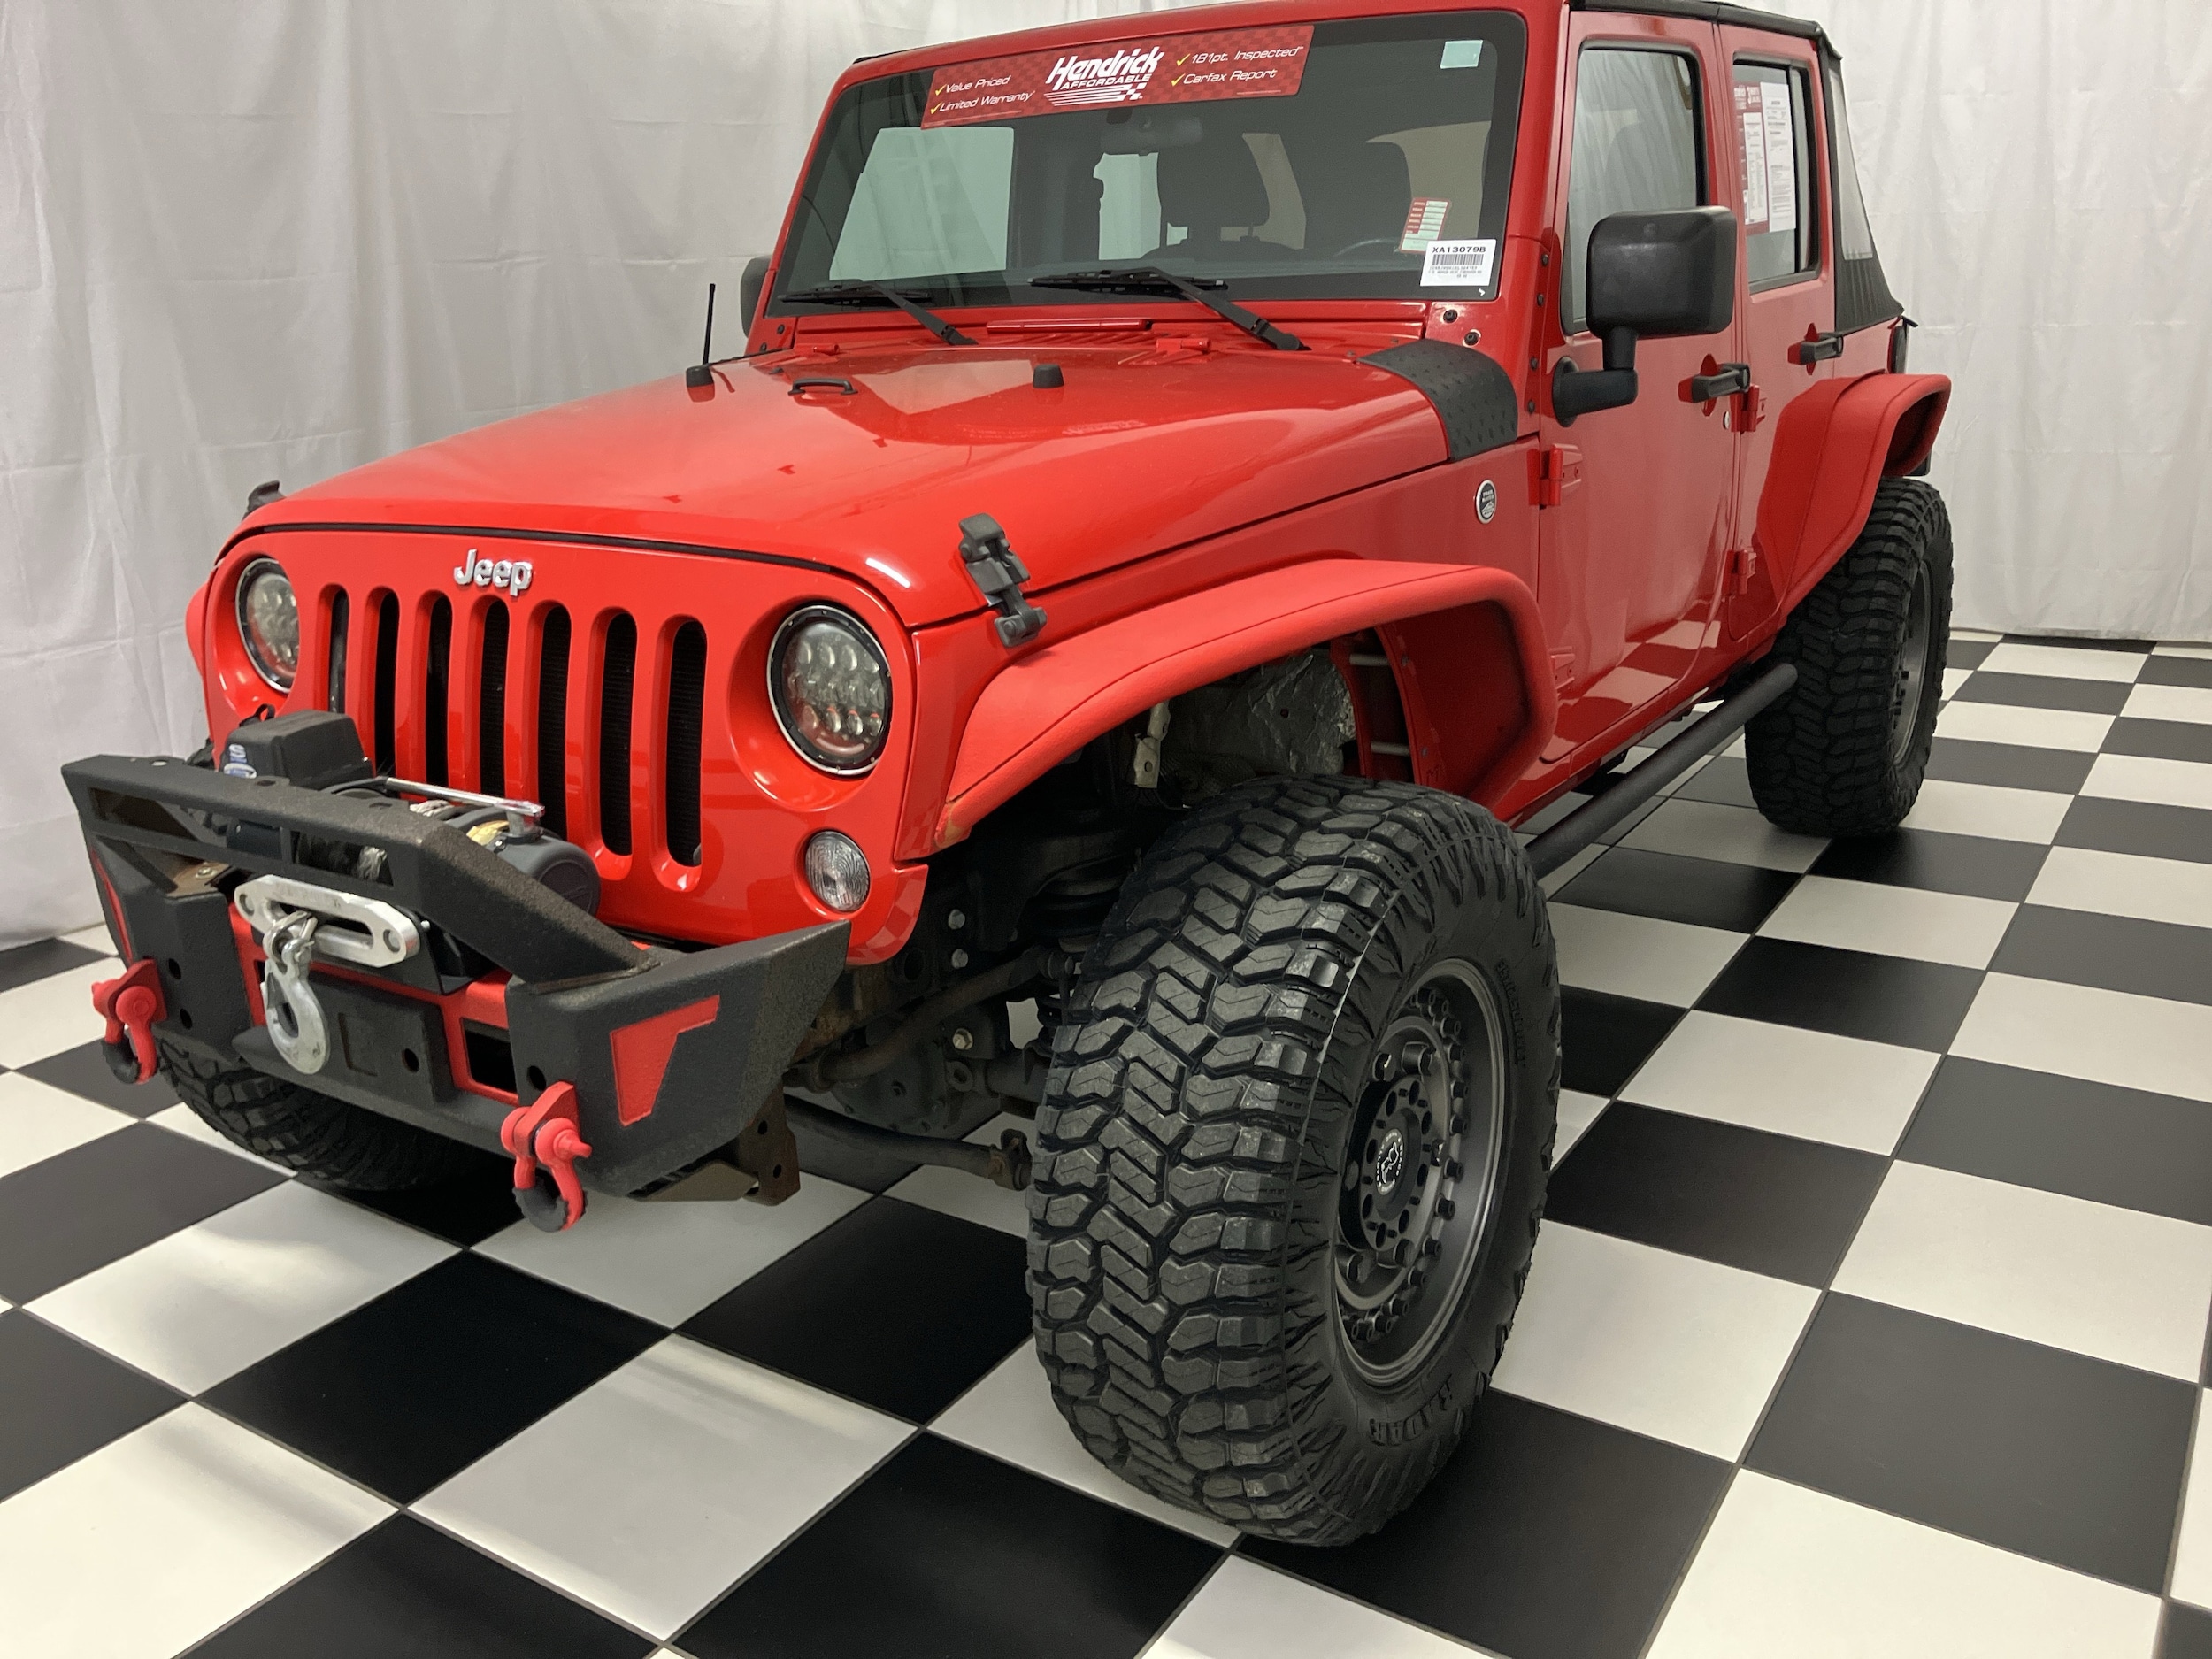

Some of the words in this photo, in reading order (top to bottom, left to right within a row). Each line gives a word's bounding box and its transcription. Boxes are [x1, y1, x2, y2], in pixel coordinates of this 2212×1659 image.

[1192, 52, 1228, 65] 181pt.
[1045, 46, 1165, 91] Hendrick
[1183, 73, 1227, 85] Carfax
[1229, 69, 1278, 82] Report
[946, 82, 973, 94] Value
[974, 74, 1011, 88] Priced
[1060, 73, 1152, 90] AFFORDABLE
[939, 97, 979, 112] Limited
[453, 549, 534, 597] Jeep
